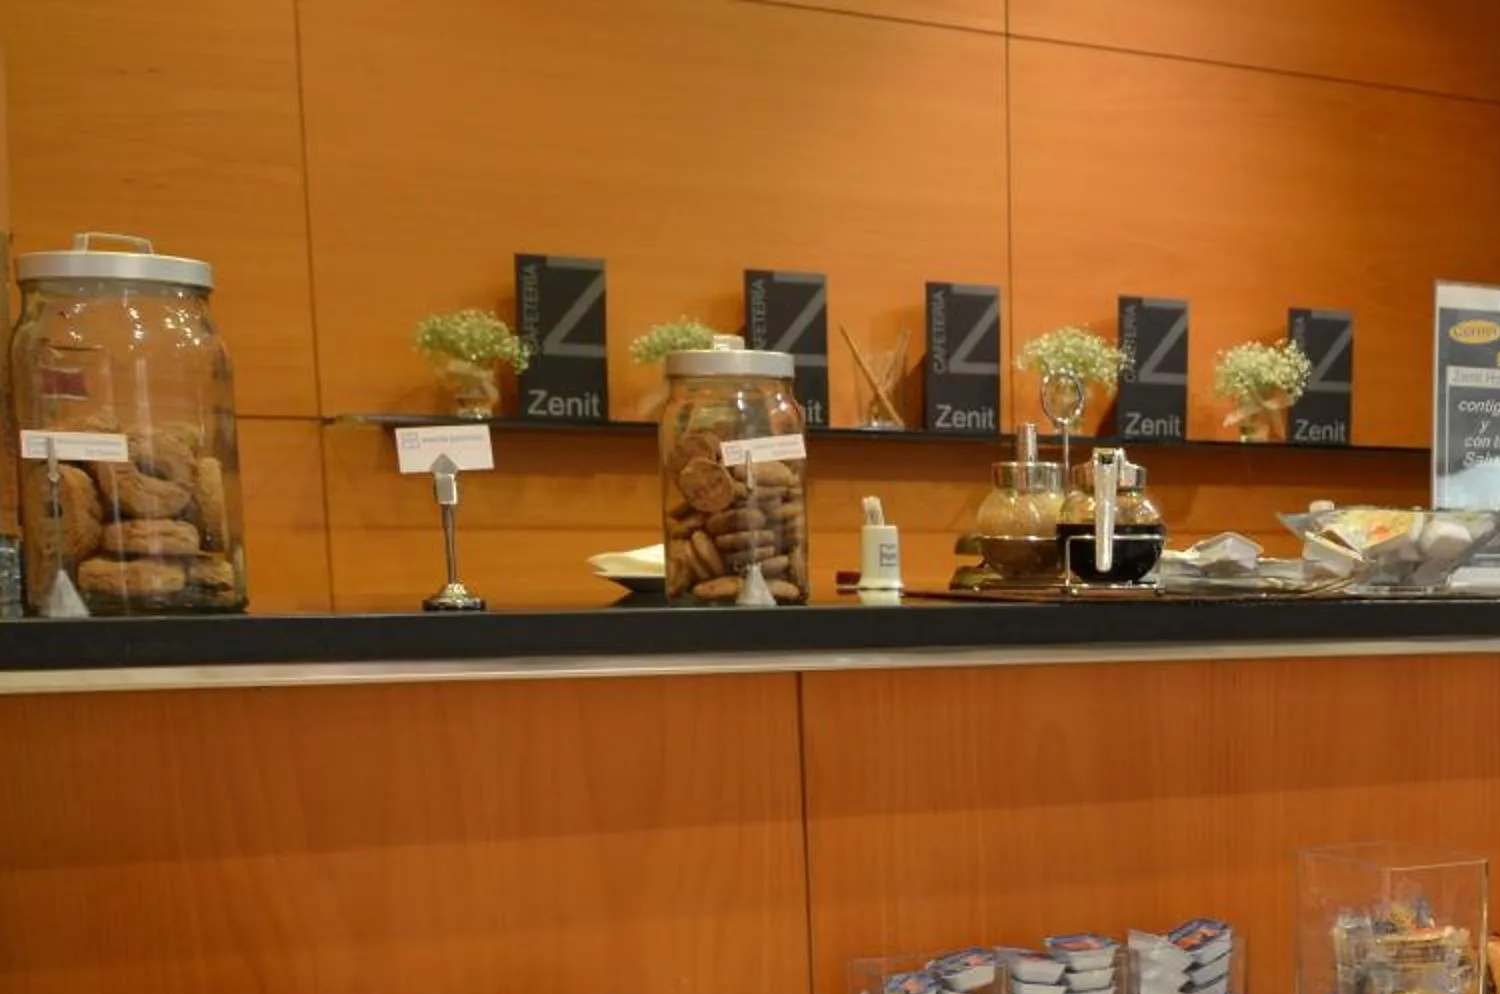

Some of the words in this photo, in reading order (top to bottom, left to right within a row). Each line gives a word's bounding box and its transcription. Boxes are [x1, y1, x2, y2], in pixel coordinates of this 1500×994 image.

[527, 389, 602, 418] Zenit
[934, 404, 996, 430] Zenit
[1125, 412, 1181, 436] Zenit
[1479, 420, 1490, 434] y
[1295, 418, 1346, 442] Zenit
[1464, 436, 1490, 448] con
